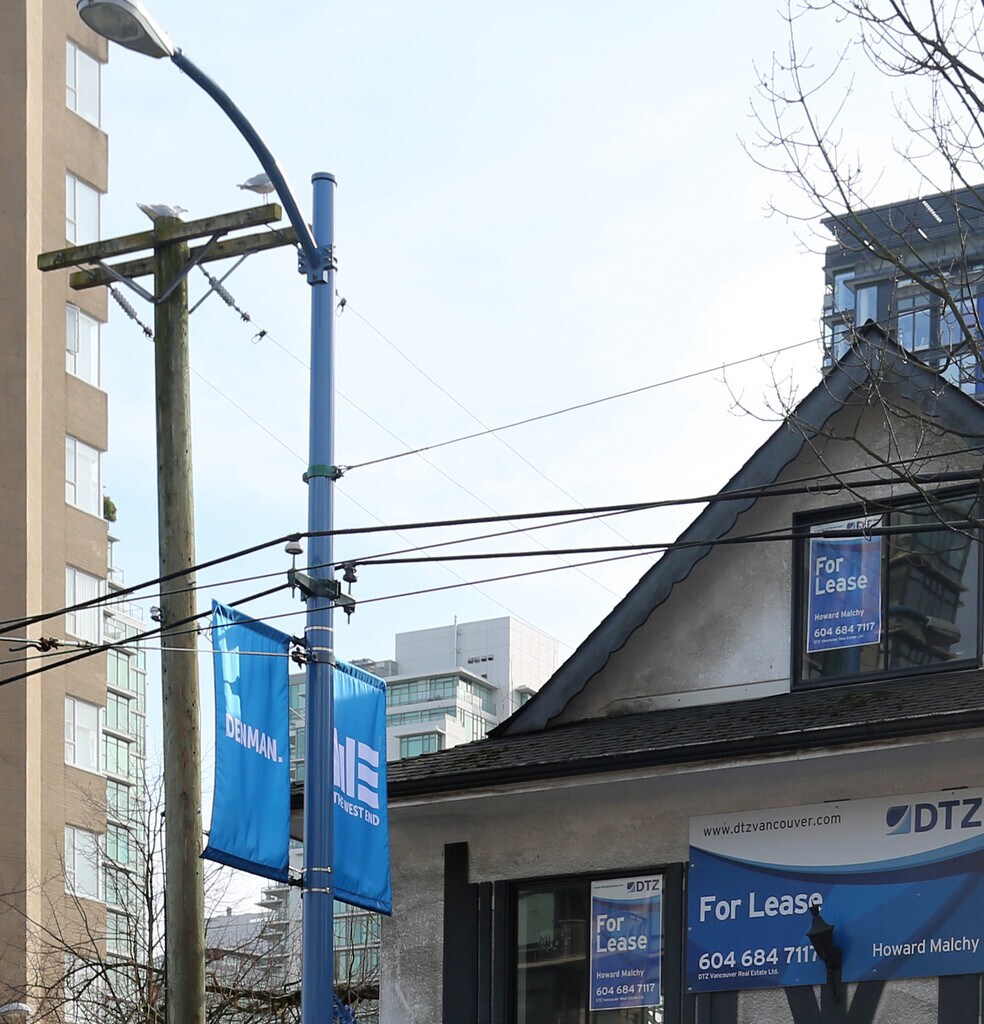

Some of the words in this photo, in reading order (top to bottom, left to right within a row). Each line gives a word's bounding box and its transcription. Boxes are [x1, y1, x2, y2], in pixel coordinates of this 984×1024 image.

[816, 556, 844, 576] For
[816, 574, 868, 596] Lease
[815, 611, 839, 621] Howard
[841, 609, 864, 618] Malchy
[814, 627, 832, 638] 604
[835, 625, 854, 635] 684
[857, 622, 875, 632] 7117
[344, 802, 364, 819] WEST
[364, 810, 380, 826] END
[914, 798, 982, 833] DTZ
[704, 813, 842, 837] www.dtzvancouver.com
[636, 880, 659, 892] DTZ
[699, 896, 742, 922] For
[749, 892, 823, 918] Lease
[597, 914, 624, 933] For
[597, 934, 647, 952] Lease
[872, 939, 926, 958] Howard
[930, 937, 980, 953] Malchy
[698, 950, 736, 971] 604
[741, 948, 778, 966] 684
[597, 970, 619, 979] Howard
[622, 969, 644, 978] Malchy
[596, 986, 614, 996] 604
[617, 985, 634, 994] 684
[637, 983, 655, 993] 7117
